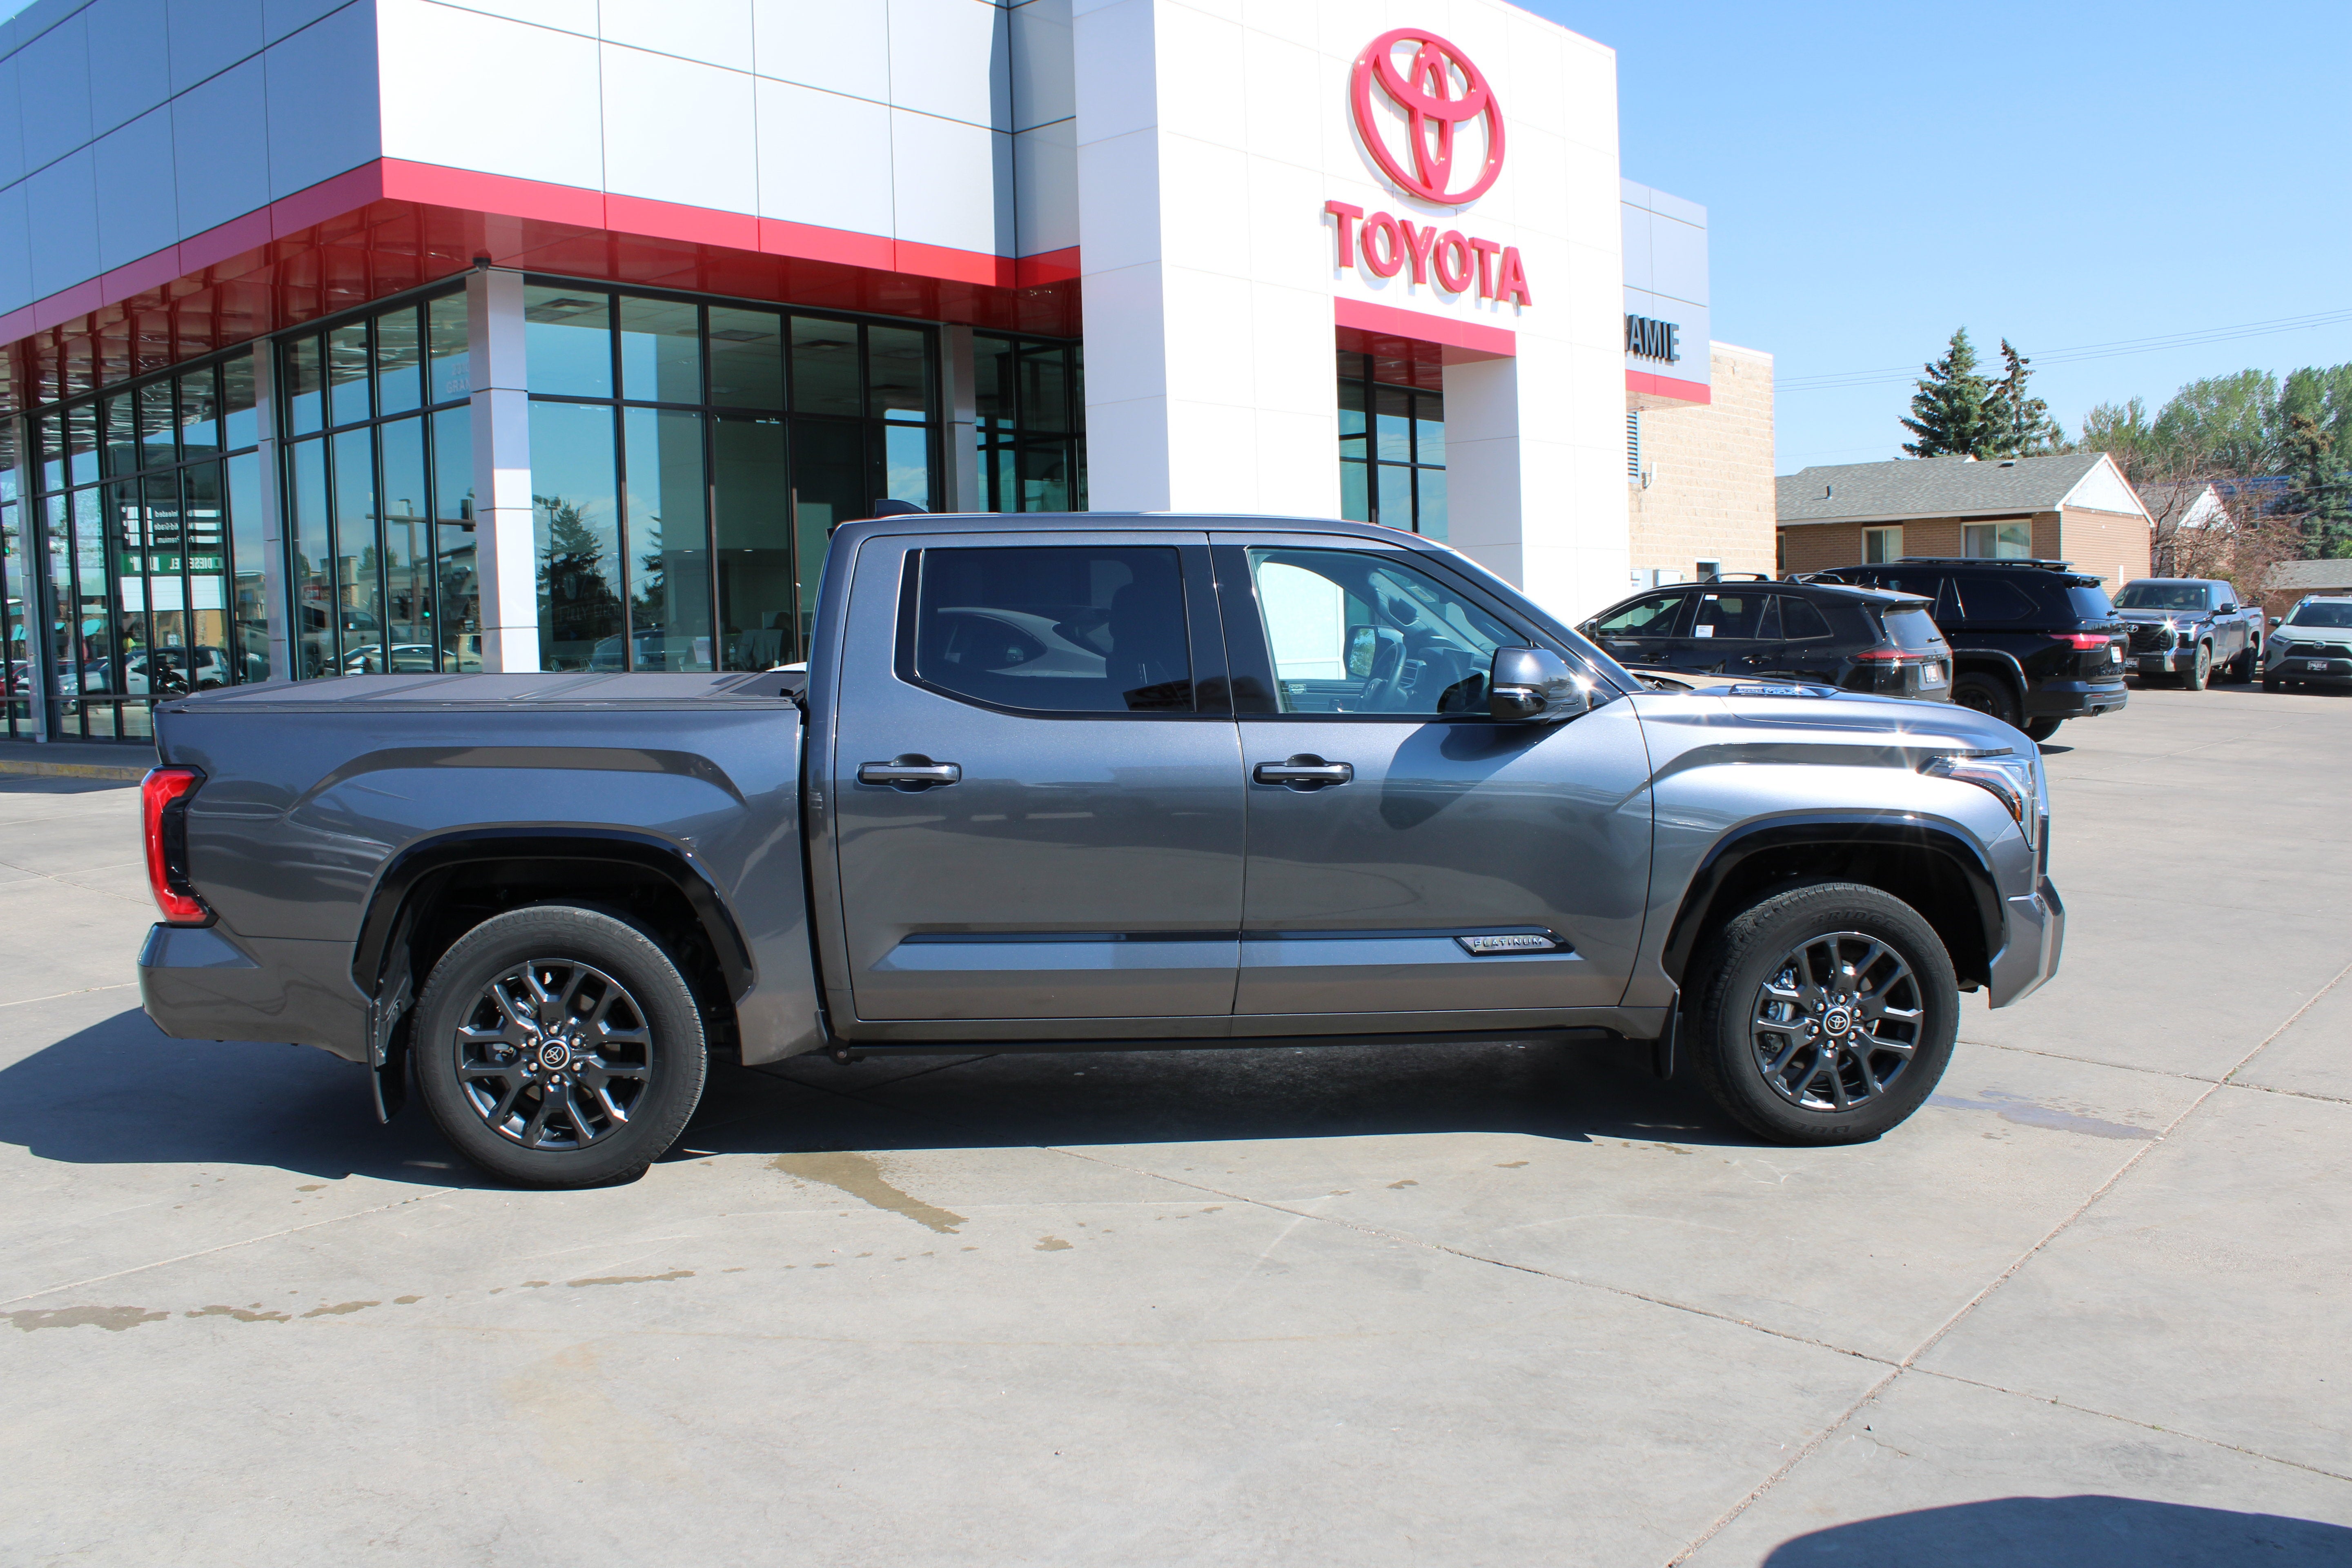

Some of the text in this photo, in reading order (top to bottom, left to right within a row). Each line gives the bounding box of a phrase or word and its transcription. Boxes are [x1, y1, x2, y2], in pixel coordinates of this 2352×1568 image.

[1325, 200, 1532, 306] TOYOTA
[1474, 938, 1542, 947] PLATINUM
[1809, 909, 1942, 984] BRIDGESTONE
[530, 933, 676, 1044] BRIDGESTONE
